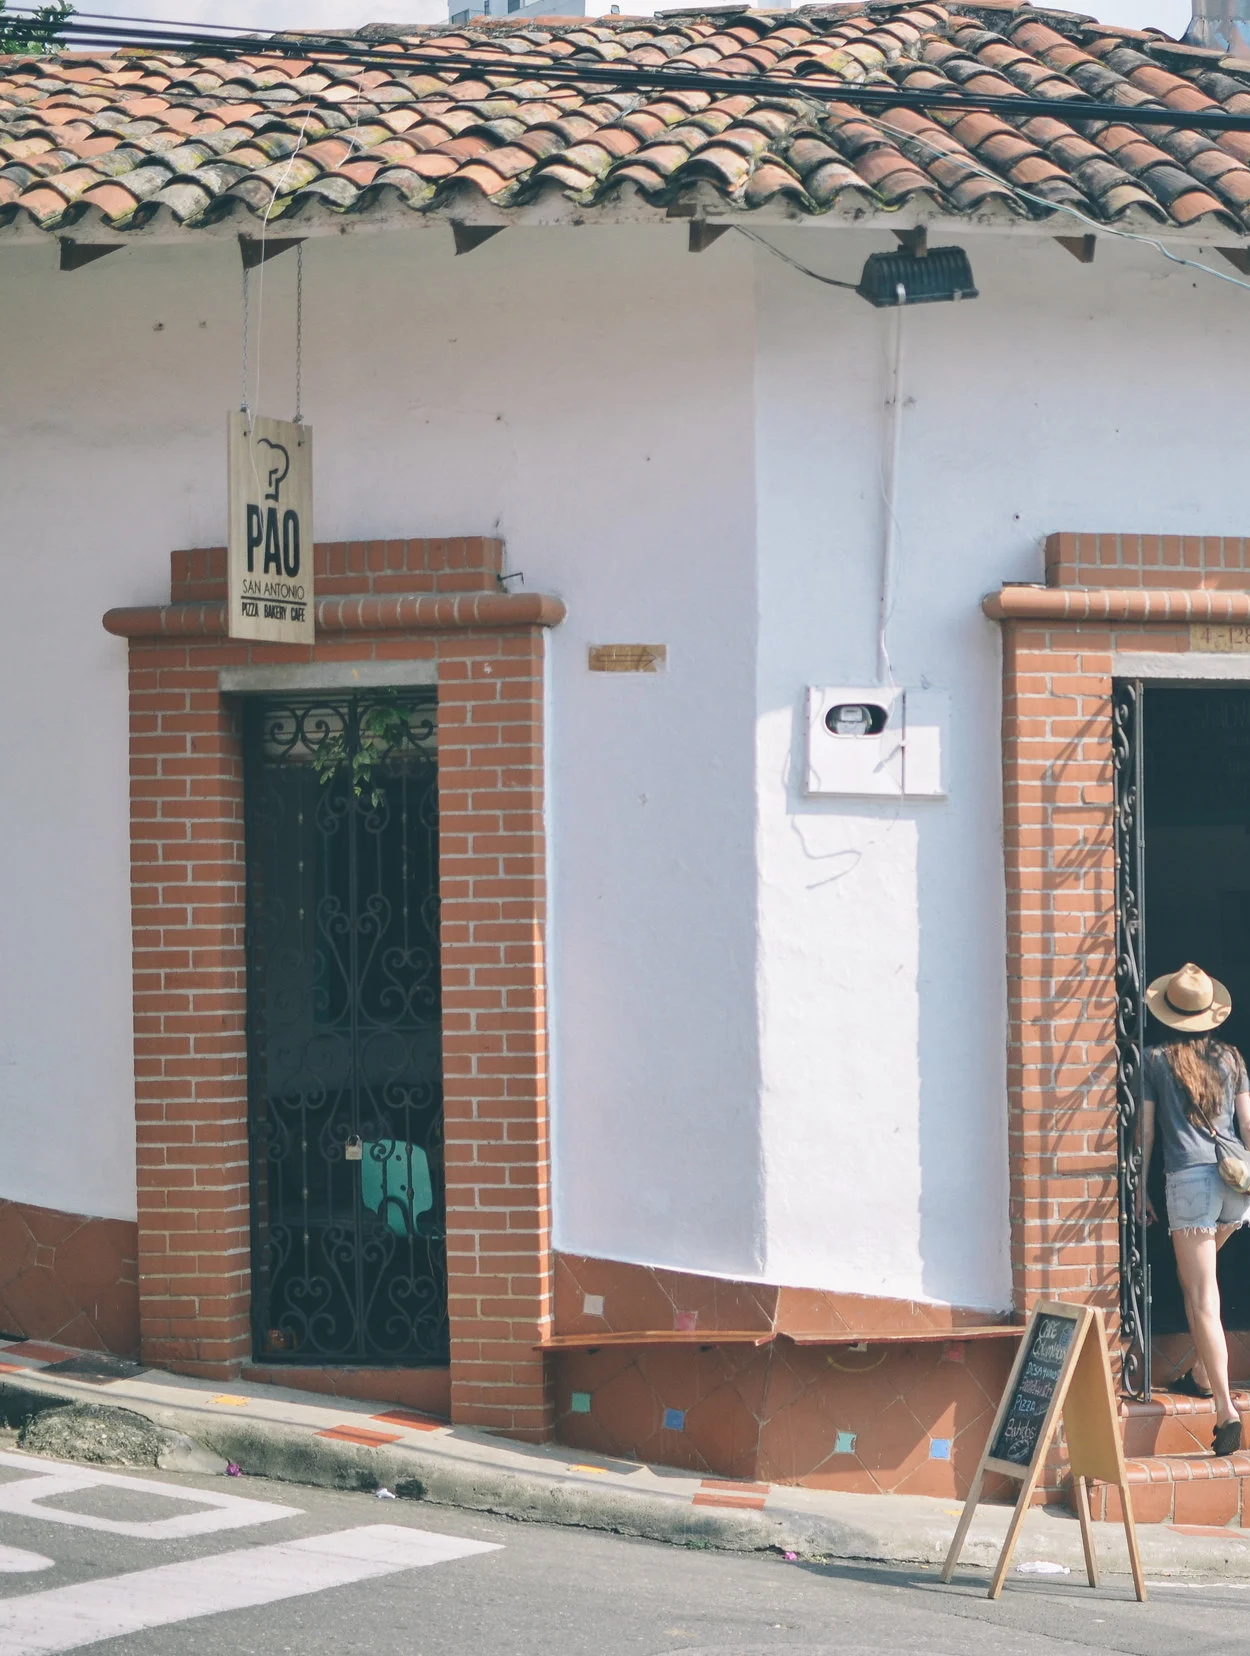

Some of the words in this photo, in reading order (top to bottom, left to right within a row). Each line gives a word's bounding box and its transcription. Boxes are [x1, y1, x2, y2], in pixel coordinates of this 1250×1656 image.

[246, 504, 300, 577] PAO
[243, 579, 261, 594] SAN
[264, 583, 304, 600] ANTONIO
[242, 603, 258, 616] PIZZA
[264, 605, 286, 619] BAKERY
